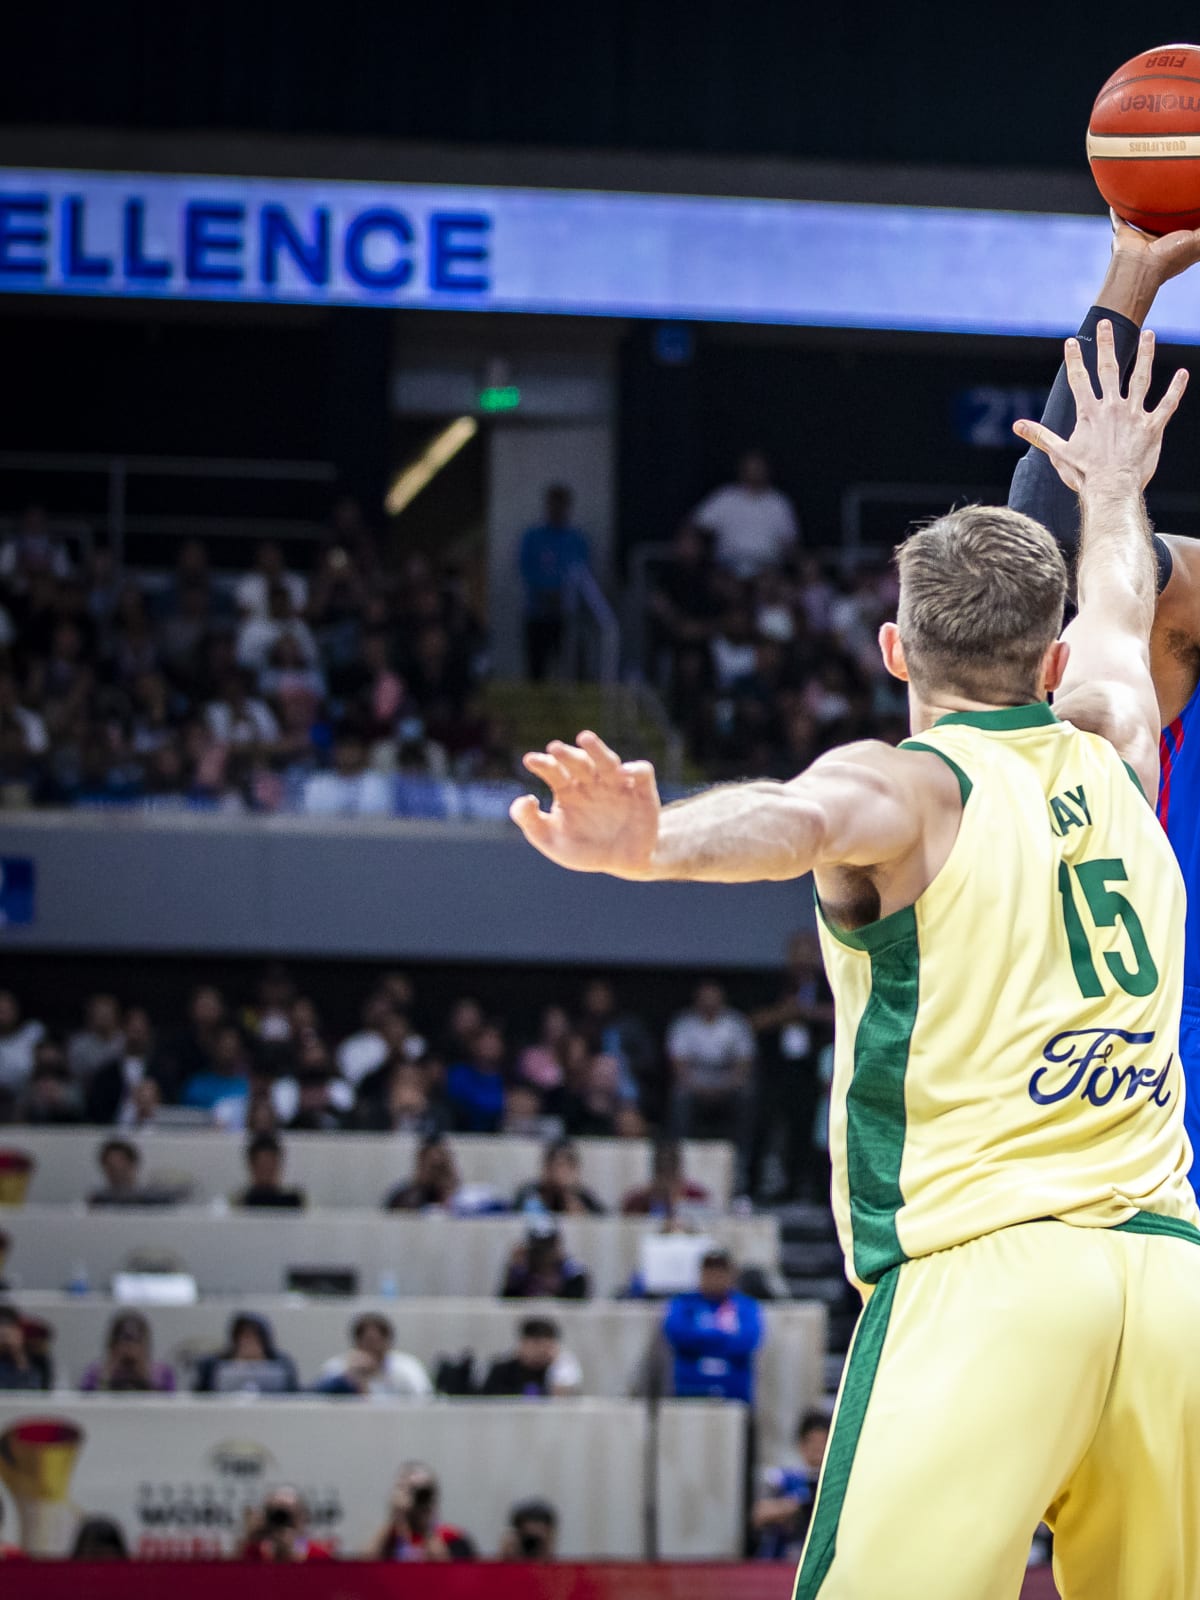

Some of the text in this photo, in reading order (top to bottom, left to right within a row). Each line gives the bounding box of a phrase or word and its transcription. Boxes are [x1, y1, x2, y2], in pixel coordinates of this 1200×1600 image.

[1145, 56, 1187, 69] FIBA
[1129, 140, 1187, 153] QUALIFIERS
[0, 192, 491, 292] ELLENCE
[1050, 784, 1093, 837] AY
[1058, 858, 1159, 998] 15
[1028, 1028, 1173, 1107] Ford
